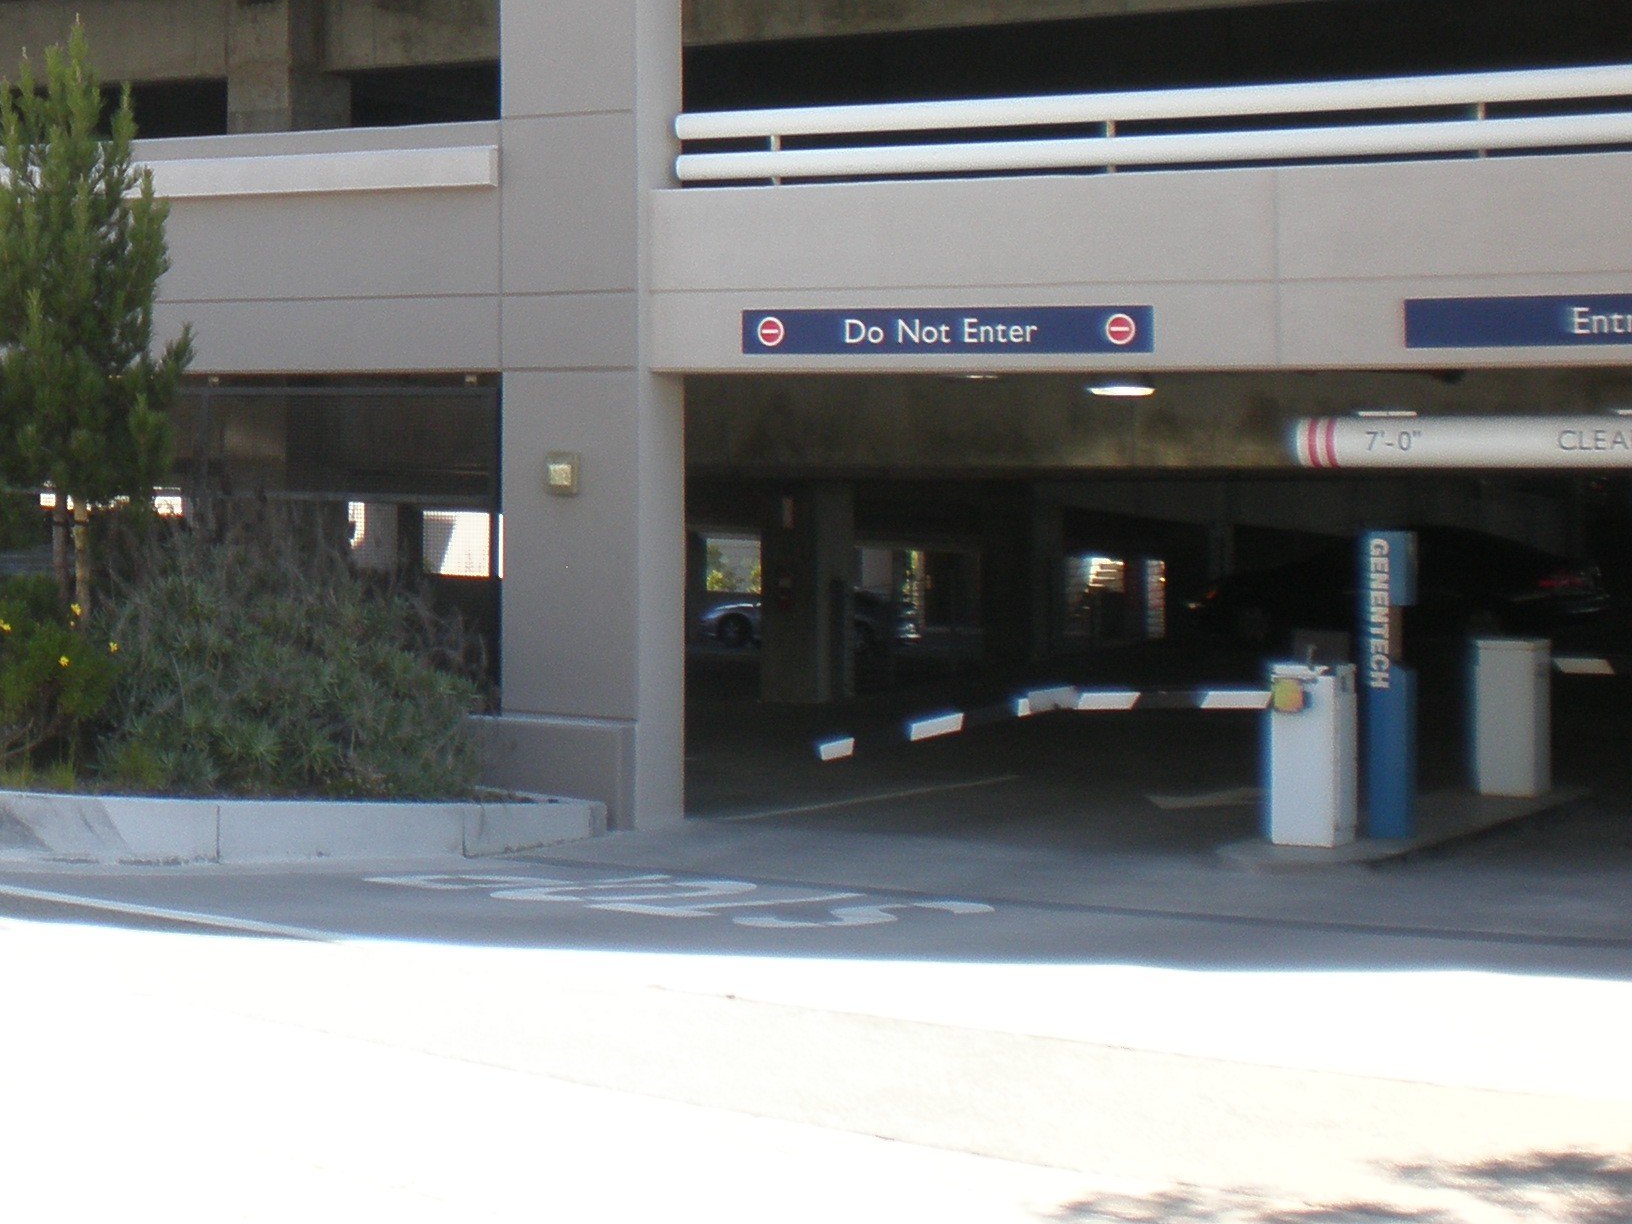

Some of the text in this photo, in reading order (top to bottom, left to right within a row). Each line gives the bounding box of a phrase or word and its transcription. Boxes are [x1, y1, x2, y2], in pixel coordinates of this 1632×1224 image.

[844, 318, 1038, 344] Do Not Enter
[1558, 428, 1632, 452] CLEA
[1369, 537, 1390, 689] GENENTECH
[363, 873, 995, 928] STOP
